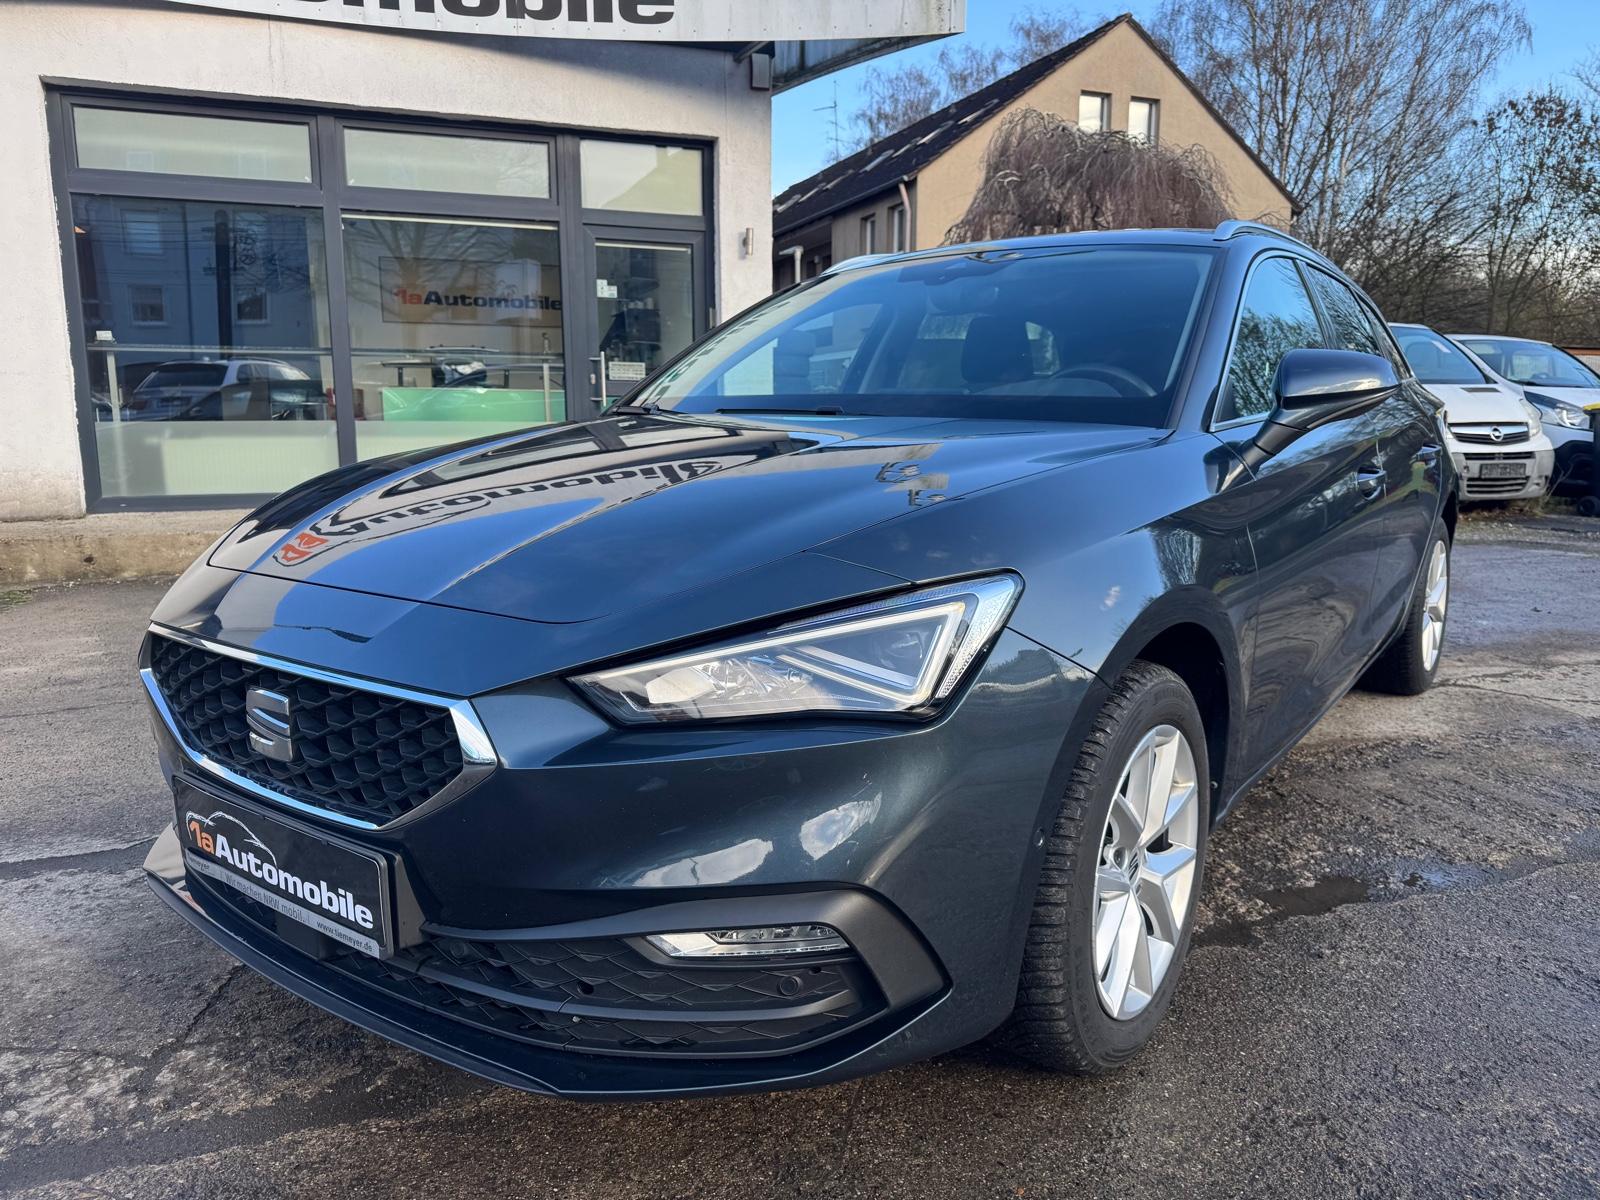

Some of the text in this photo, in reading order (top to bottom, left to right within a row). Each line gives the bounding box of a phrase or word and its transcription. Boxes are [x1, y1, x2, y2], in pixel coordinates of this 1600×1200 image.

[189, 821, 374, 929] 1aAutomobile
[236, 879, 262, 901] machen
[263, 893, 280, 911] NRW
[316, 920, 373, 952] www.tiemeyer.de
